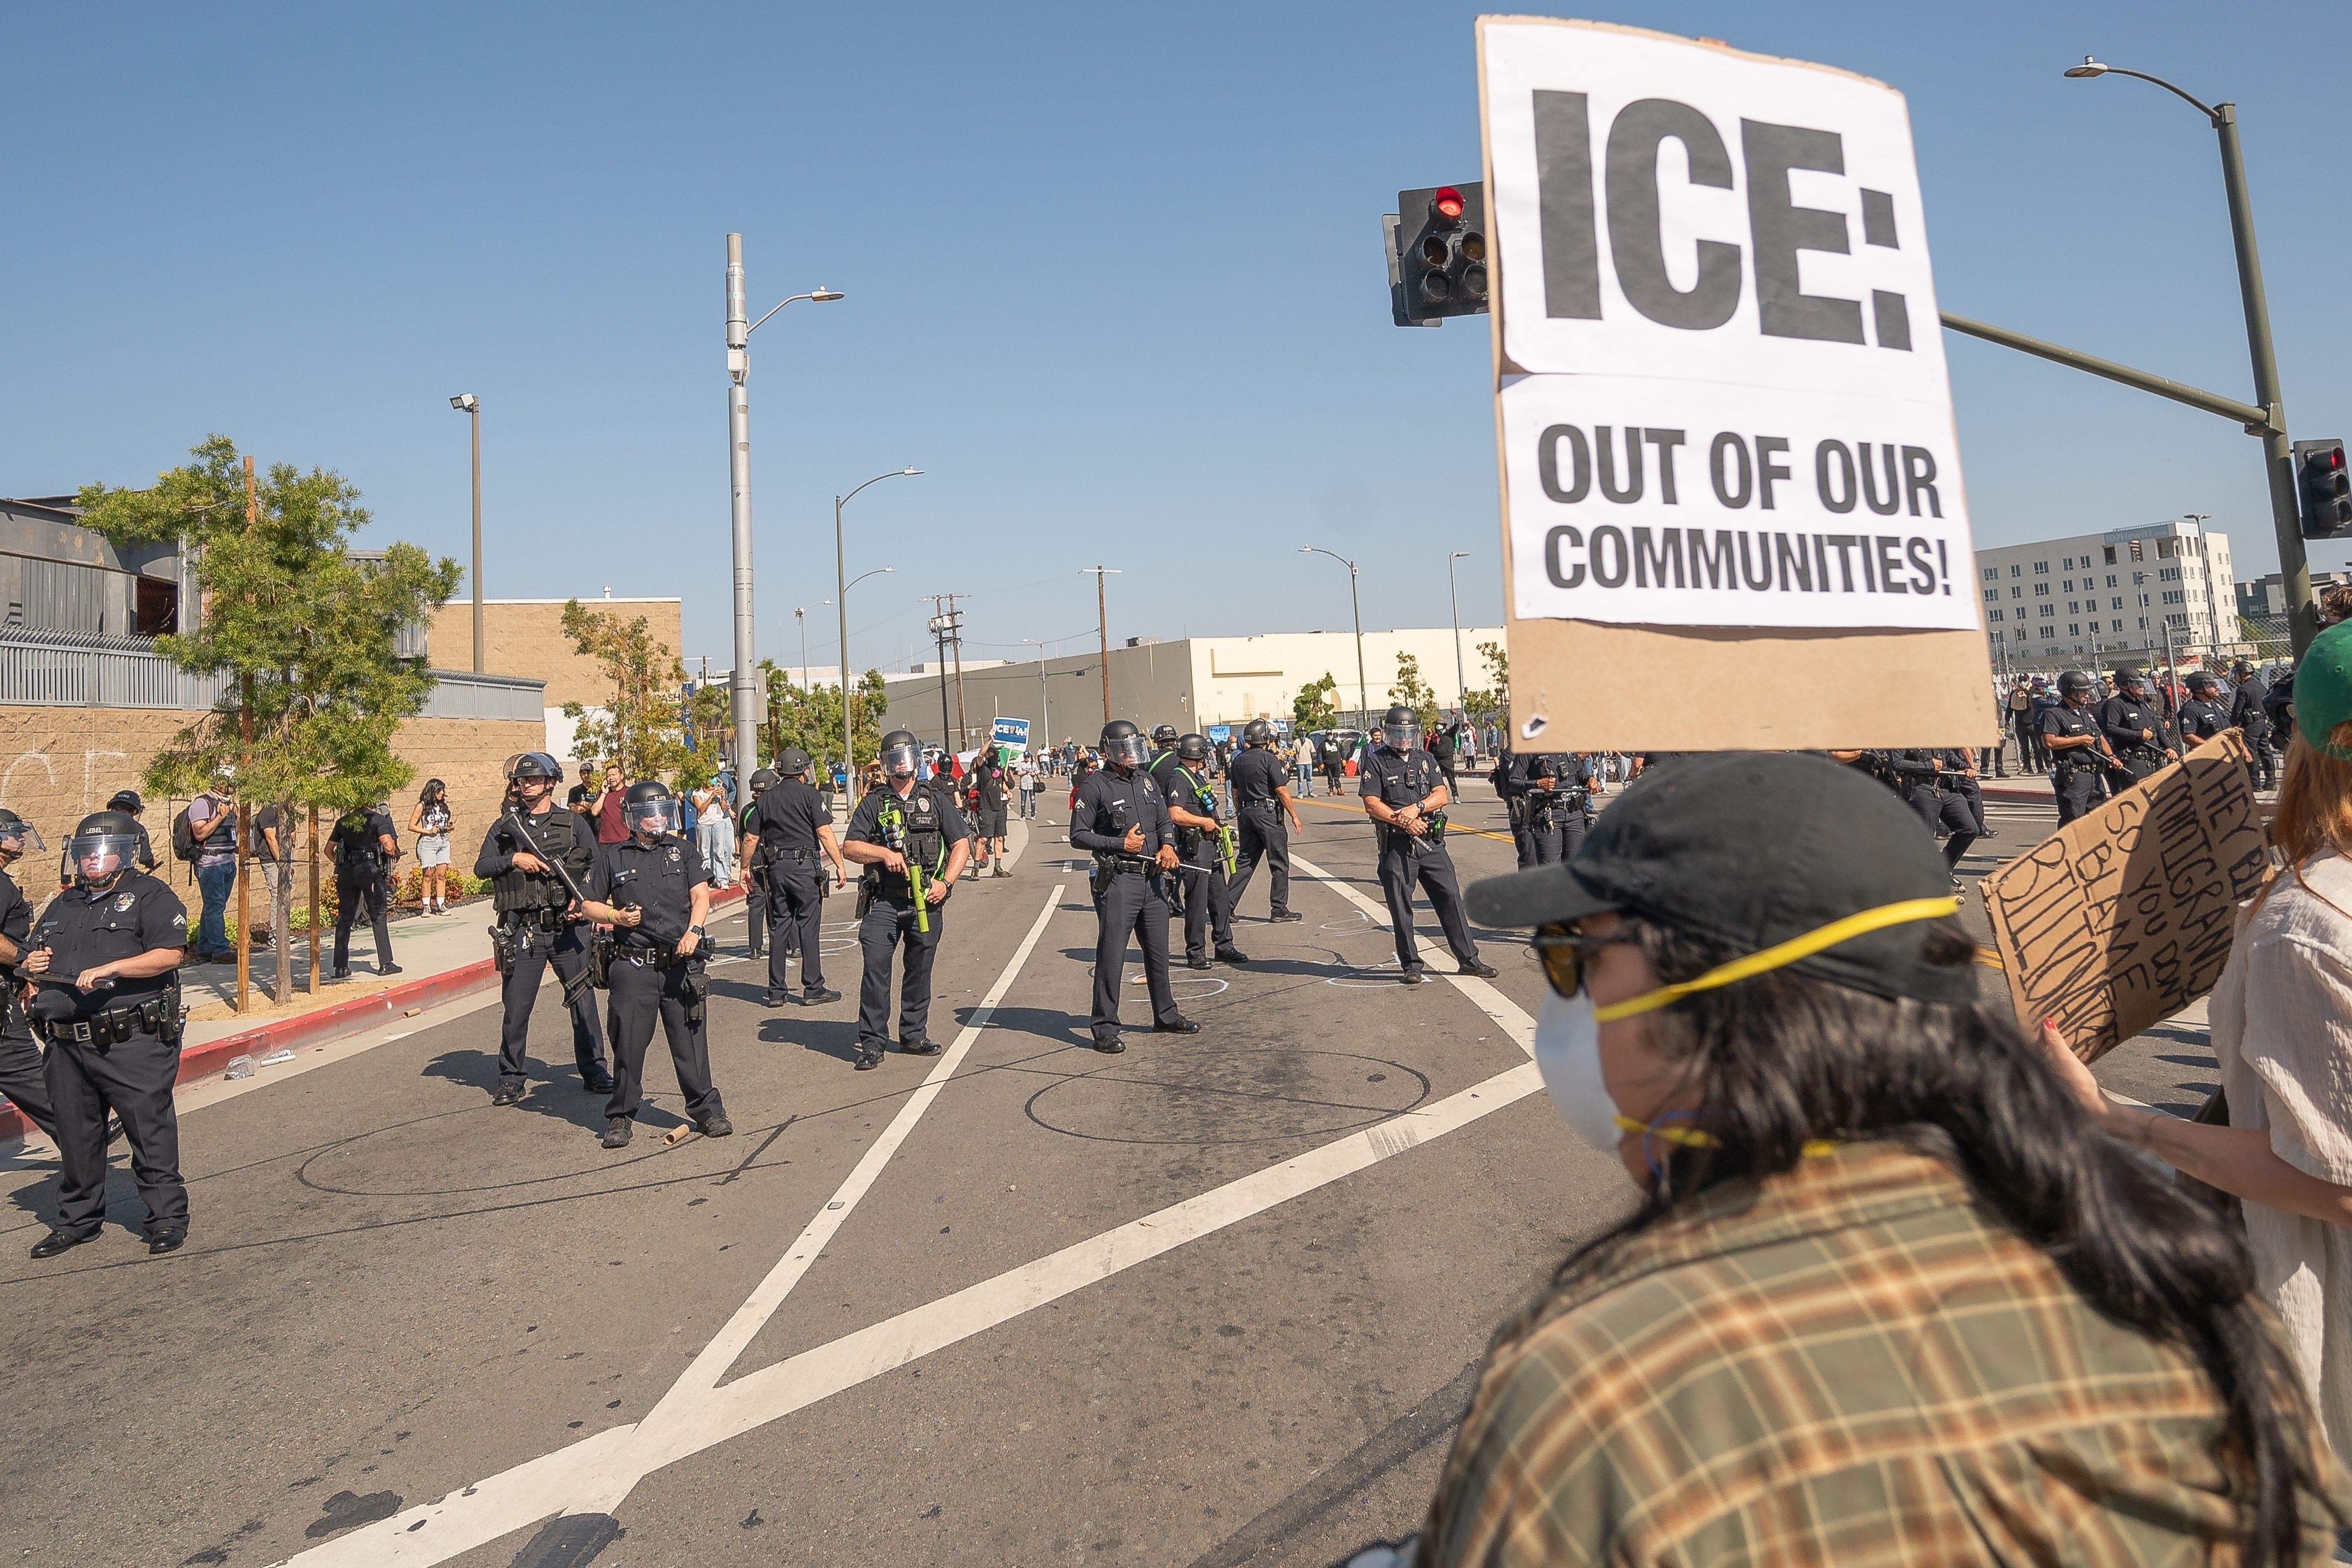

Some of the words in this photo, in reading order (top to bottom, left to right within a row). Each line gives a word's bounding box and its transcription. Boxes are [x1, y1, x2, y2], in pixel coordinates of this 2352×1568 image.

[1532, 89, 1913, 351] ICE:
[1538, 424, 1685, 505] OUT
[1709, 431, 1791, 510] OF
[1815, 439, 1943, 519] OUR
[1544, 524, 1951, 596] COMMUNITIES!
[2196, 739, 2258, 845] THEY
[2075, 839, 2150, 1001] BLAME
[2105, 800, 2143, 854] SO
[2127, 866, 2168, 936] YOU
